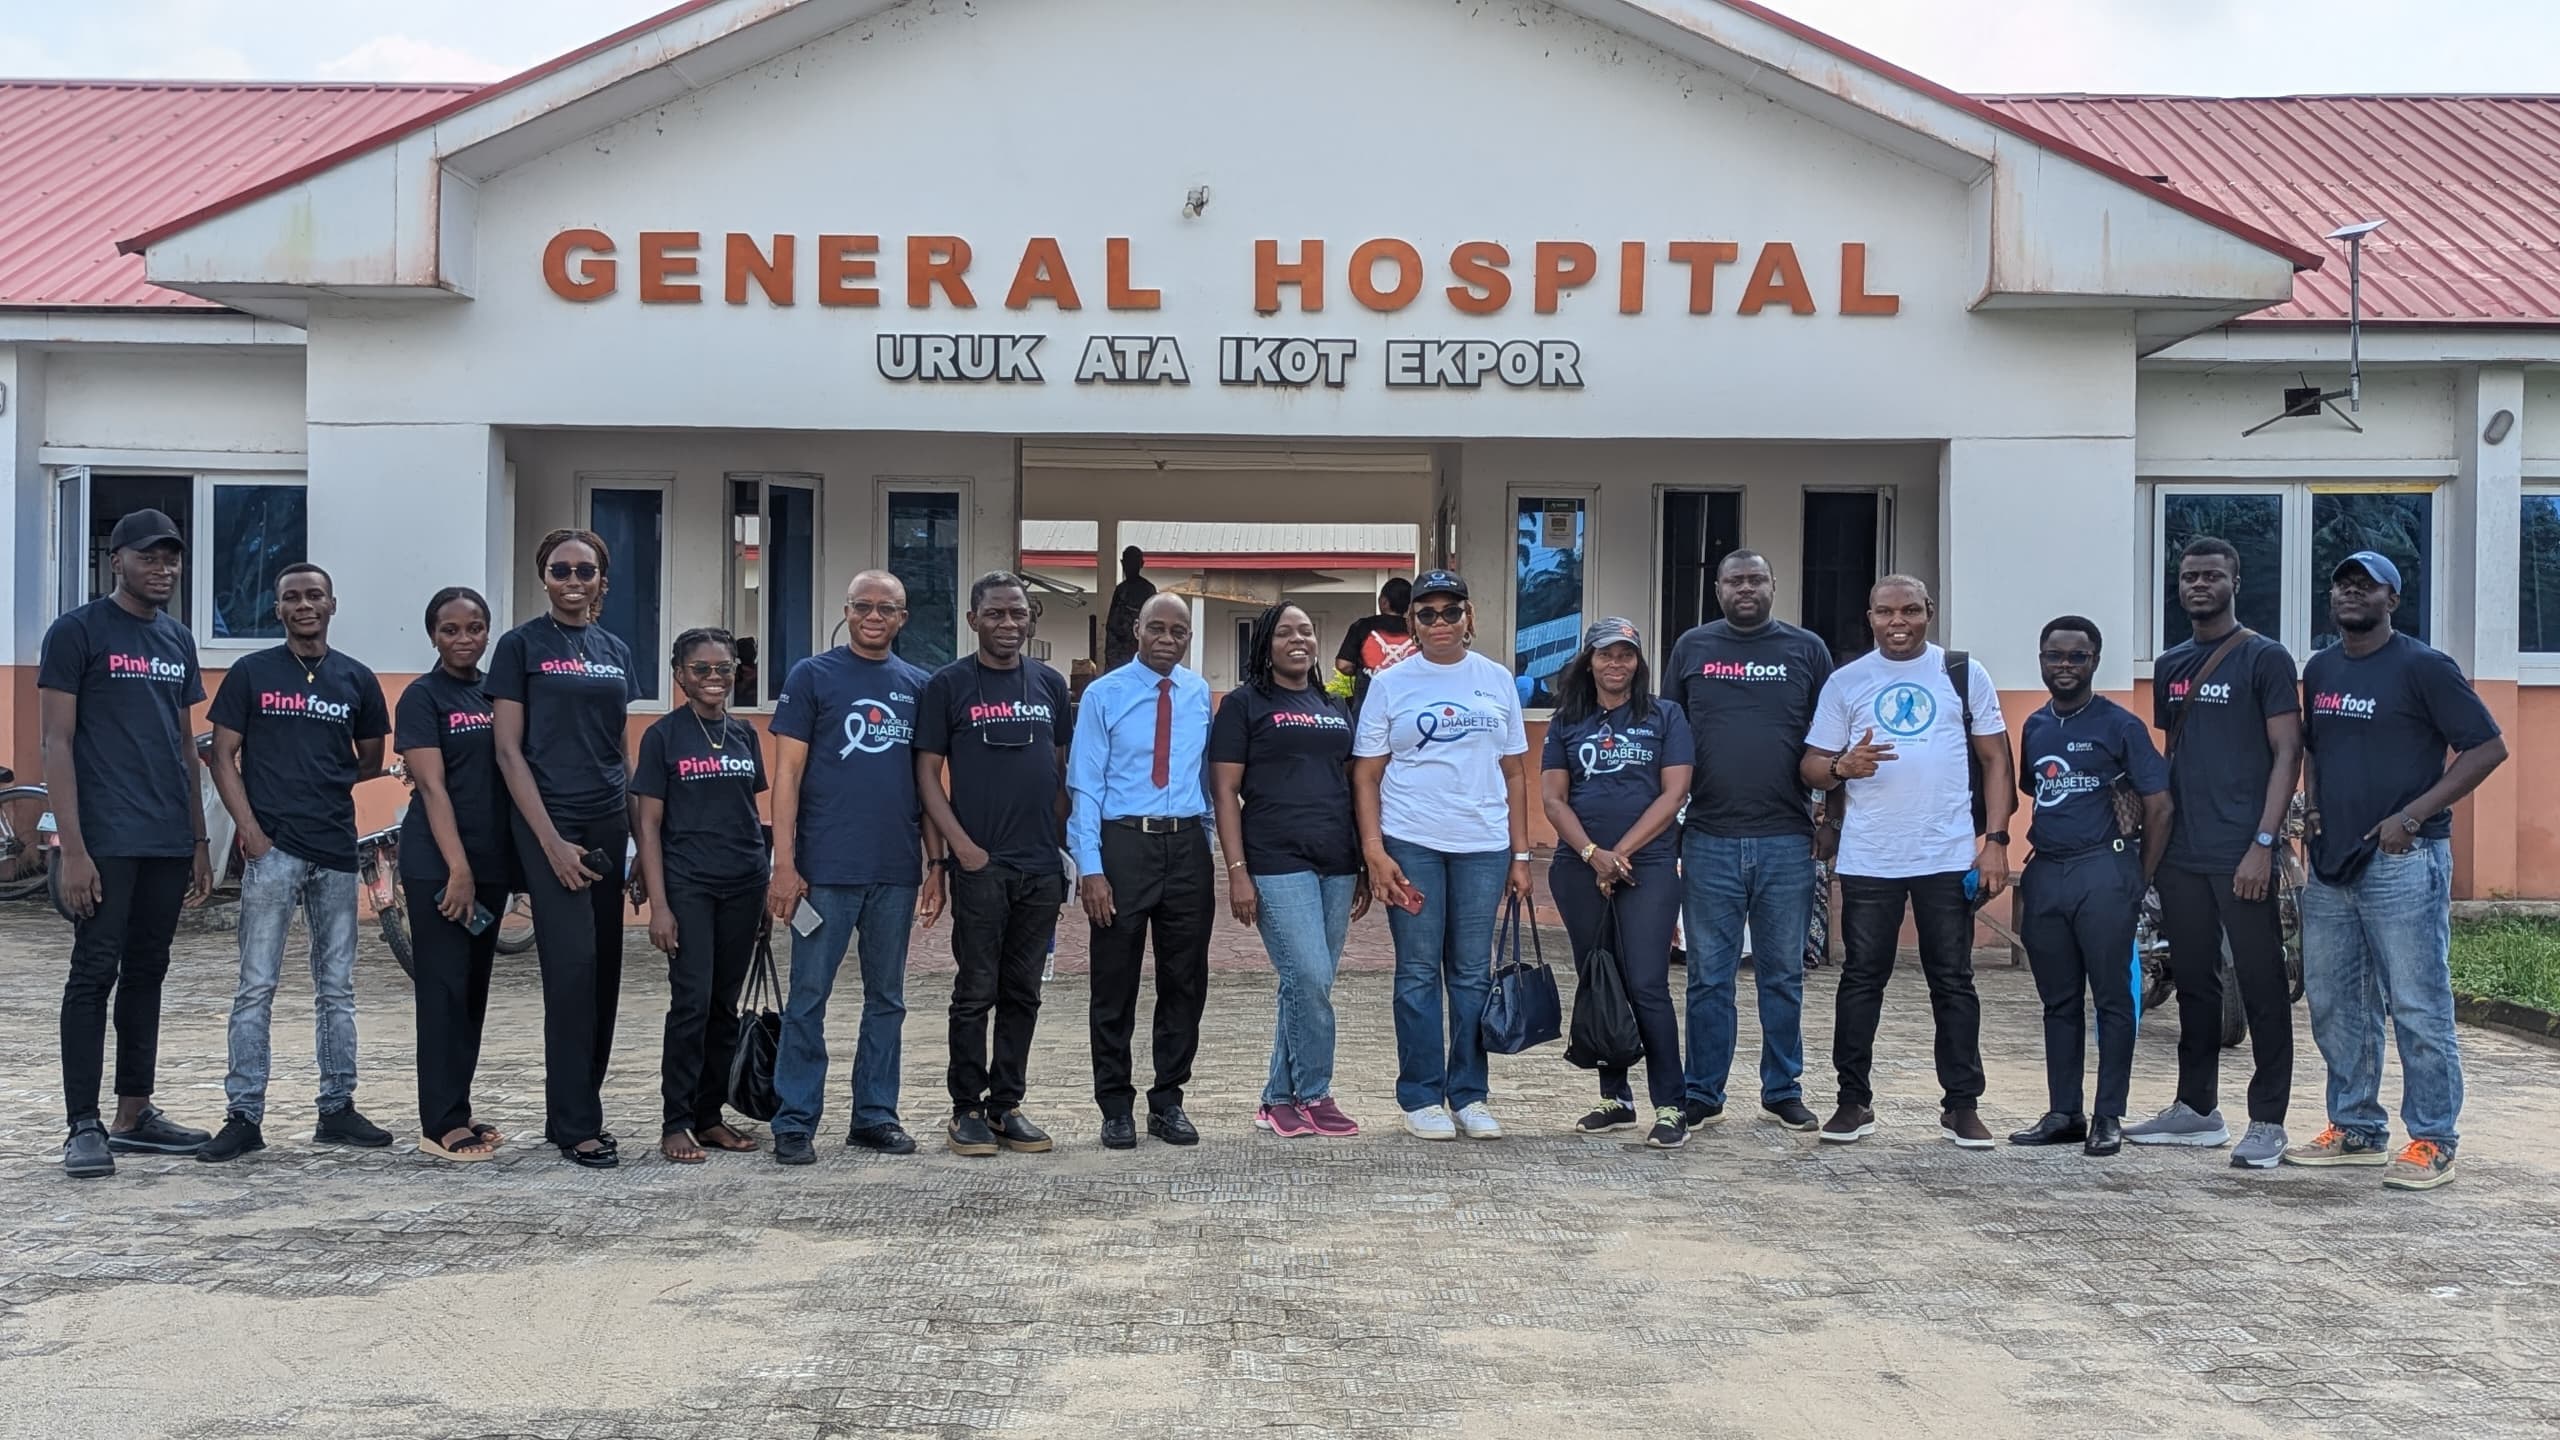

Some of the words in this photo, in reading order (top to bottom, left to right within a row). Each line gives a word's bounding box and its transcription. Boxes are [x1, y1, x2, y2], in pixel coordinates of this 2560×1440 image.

[543, 228, 1161, 309] GENERAL
[1254, 237, 1900, 316] HOSPITAL
[876, 334, 1045, 383] URUK
[1075, 336, 1190, 384] ATA
[1220, 337, 1356, 387] IKOT
[1386, 340, 1584, 388] EKPOR
[109, 653, 186, 679] Pinkfoot
[1703, 661, 1788, 677] Pinkfoot
[261, 691, 351, 719] Pinkfoot
[970, 701, 1051, 722] Pinkfoot
[449, 711, 494, 728] Pink
[882, 718, 909, 727] WORLD
[1441, 716, 1499, 728] DIABETES
[868, 723, 914, 740] DIABETE
[1600, 748, 1654, 761] DIABETES
[2045, 776, 2100, 790] DIABETES
